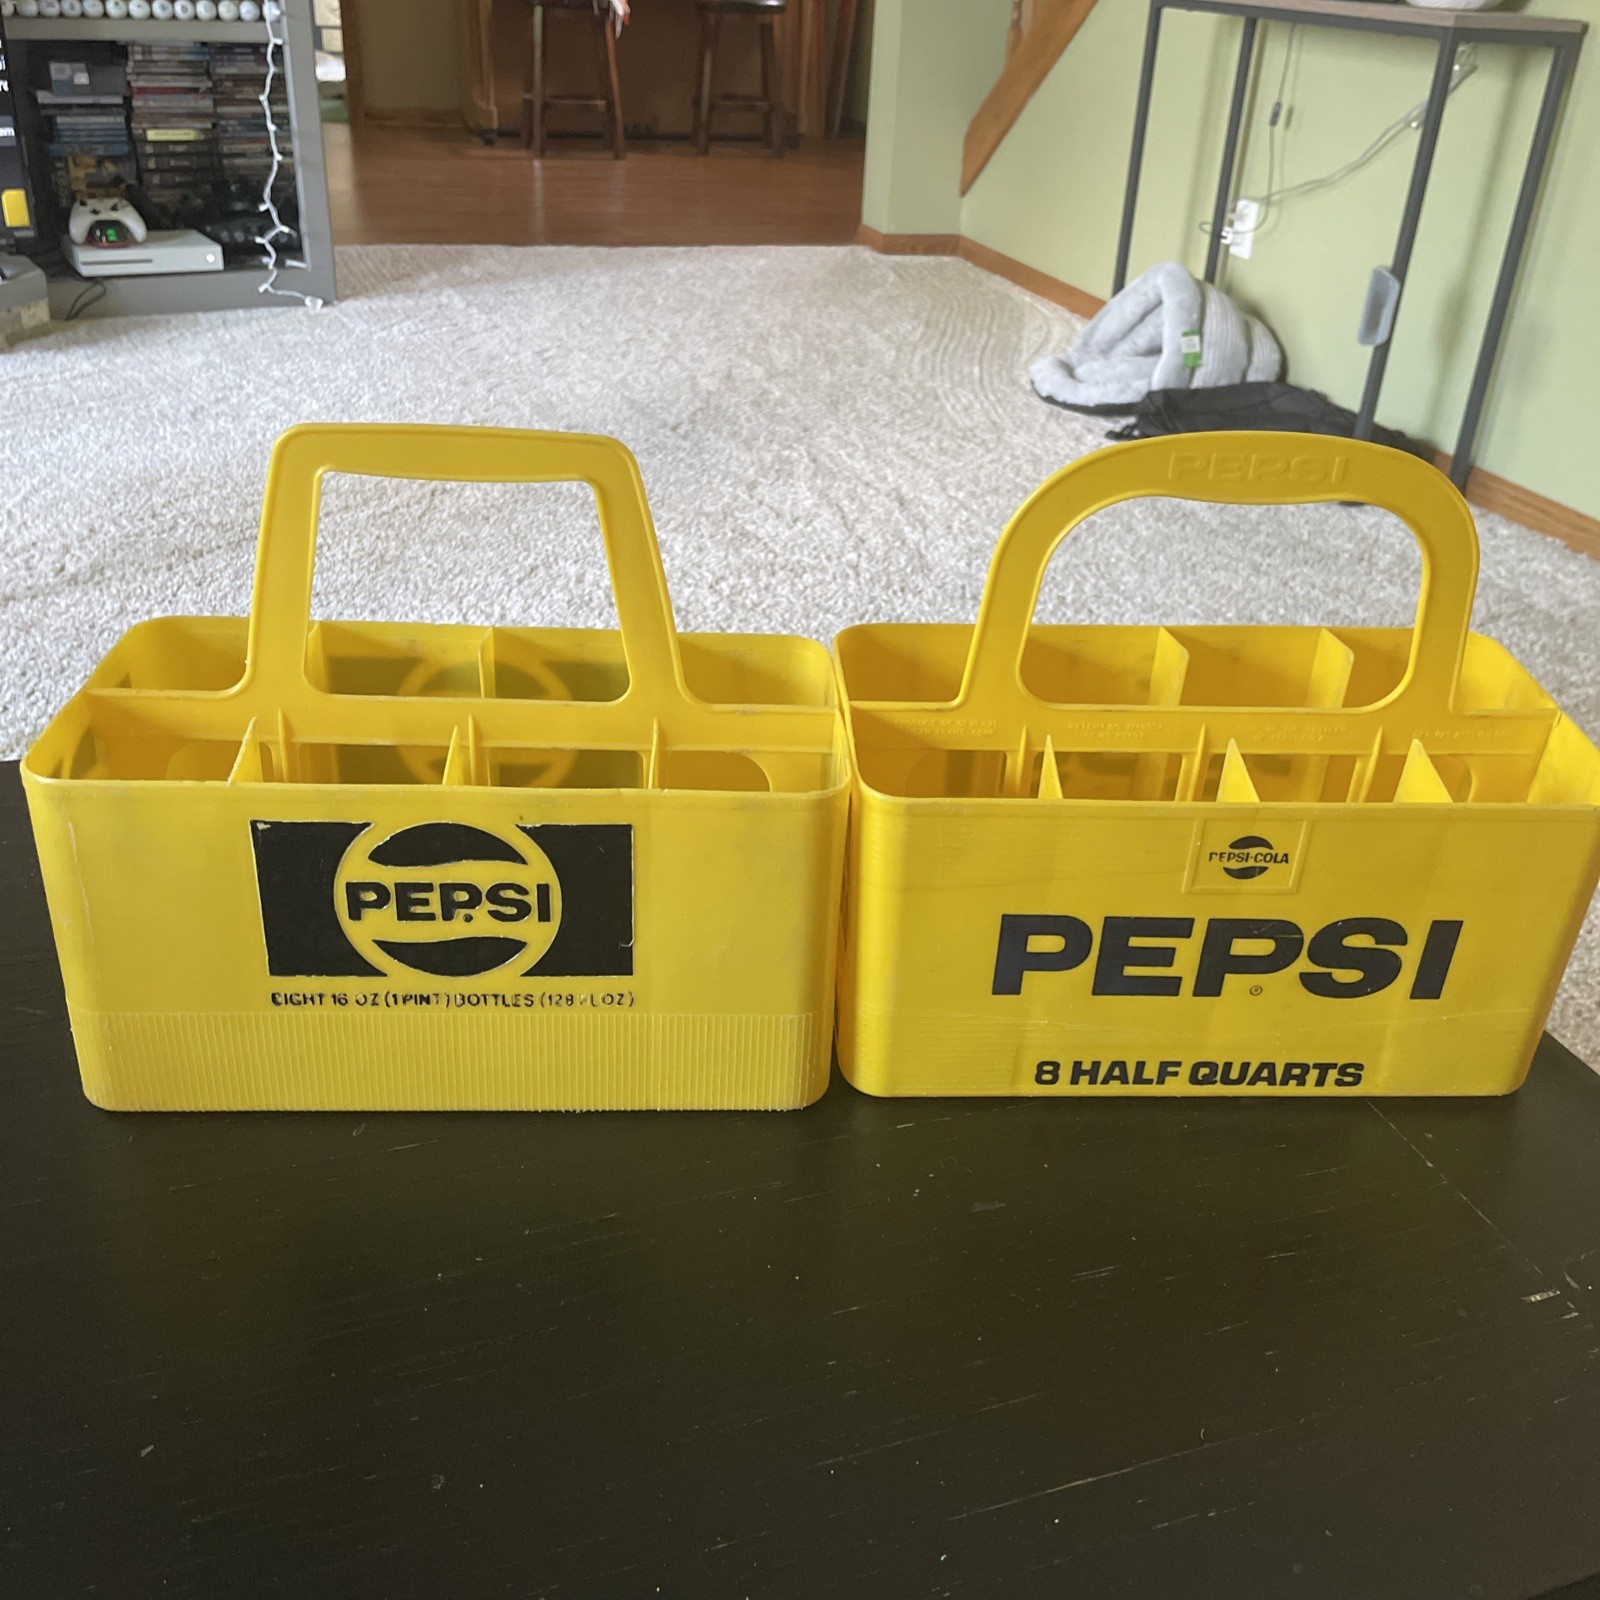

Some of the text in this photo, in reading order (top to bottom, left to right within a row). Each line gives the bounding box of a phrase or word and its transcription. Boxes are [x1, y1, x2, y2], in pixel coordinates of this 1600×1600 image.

[1167, 452, 1350, 485] PEPSI
[344, 881, 552, 923] PEPSI
[991, 913, 1464, 1000] PEPSI
[270, 992, 325, 1006] EIGHT
[330, 993, 349, 1006] 16
[354, 992, 380, 1006] OZ
[454, 992, 535, 1008] BOTTLES
[1034, 1060, 1366, 1089] 8 HALF QUARTS
